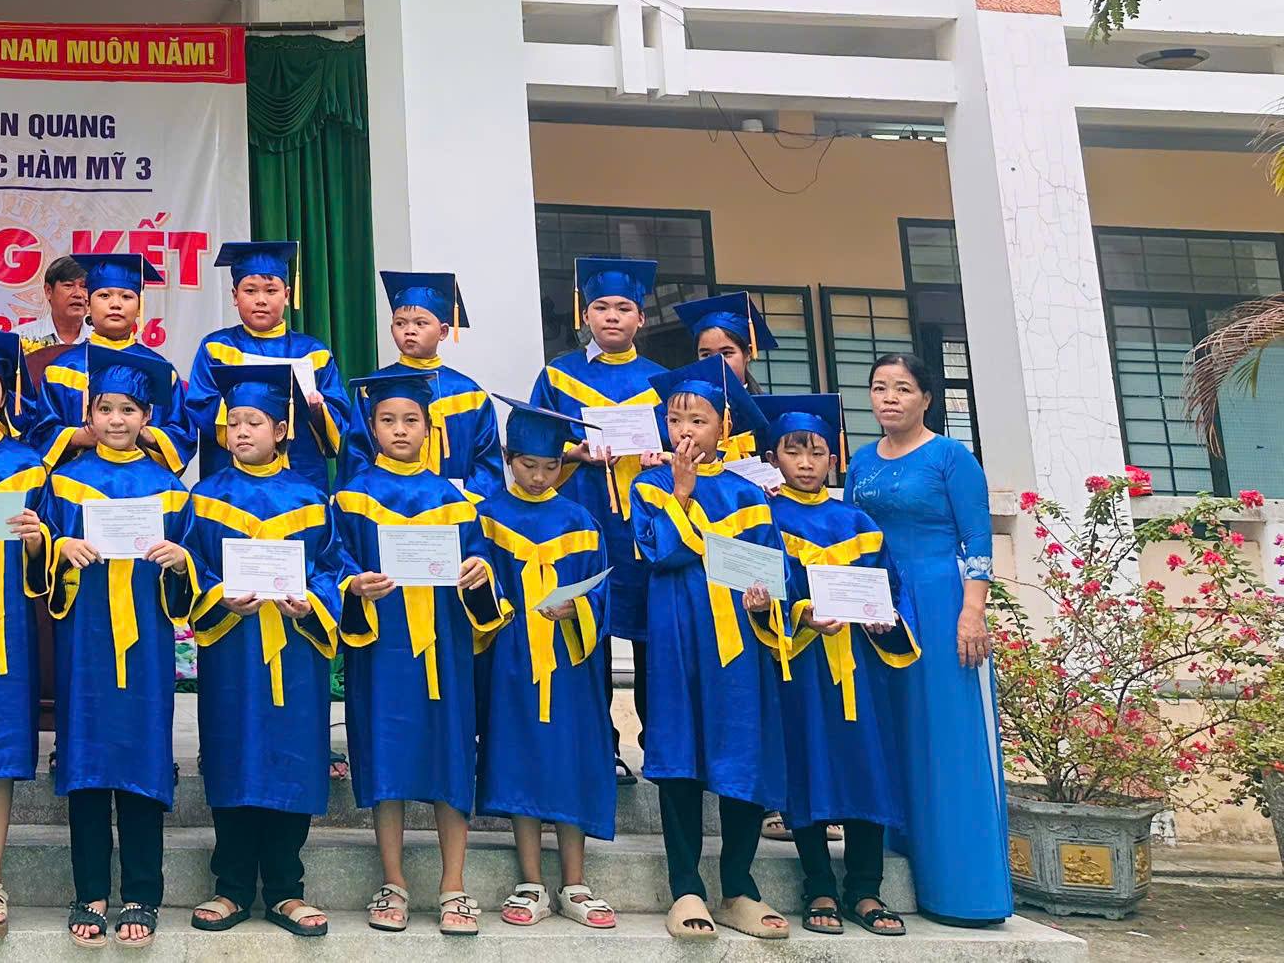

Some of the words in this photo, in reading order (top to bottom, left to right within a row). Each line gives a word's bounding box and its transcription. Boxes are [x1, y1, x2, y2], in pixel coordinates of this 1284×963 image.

[0, 38, 58, 63] NAM
[66, 37, 140, 65] MUÔN
[147, 37, 215, 66] NĂM!
[28, 113, 116, 139] QUANG
[17, 150, 78, 180] HÀM
[85, 151, 127, 180] MỸ
[135, 157, 152, 180] 3
